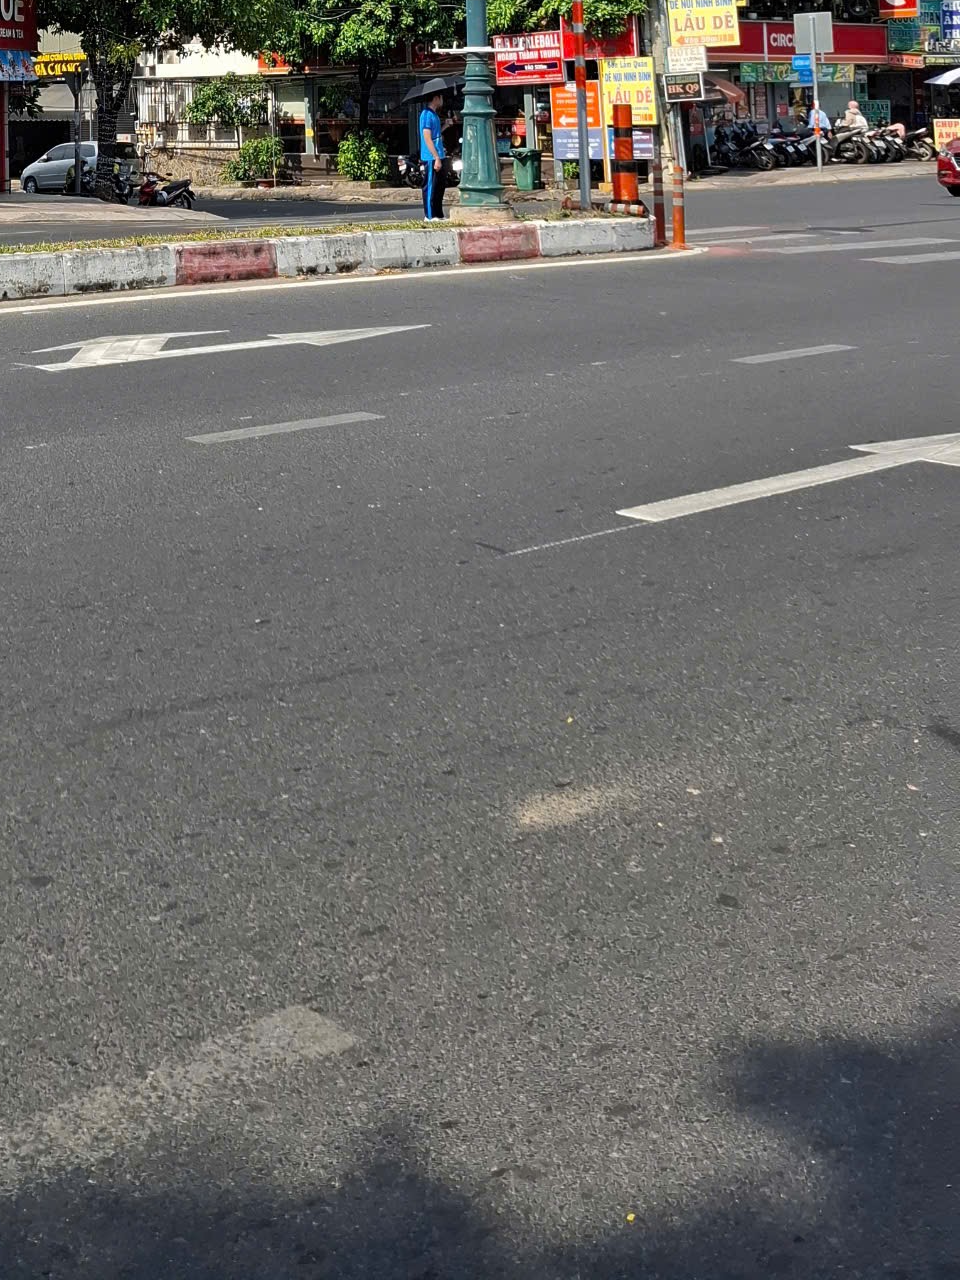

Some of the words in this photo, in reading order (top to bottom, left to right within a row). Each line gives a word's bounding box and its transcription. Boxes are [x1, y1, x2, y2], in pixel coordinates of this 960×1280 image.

[674, 9, 706, 32] LẨU
[713, 11, 735, 30] DÊ
[16, 29, 24, 39] TEA
[770, 33, 796, 46] CIRC
[512, 34, 560, 49] PICKLEBALL
[624, 72, 637, 82] NINH
[608, 83, 631, 104] LẨU
[636, 86, 653, 104] DÊ
[668, 84, 684, 94] HK
[686, 83, 699, 94] Q9
